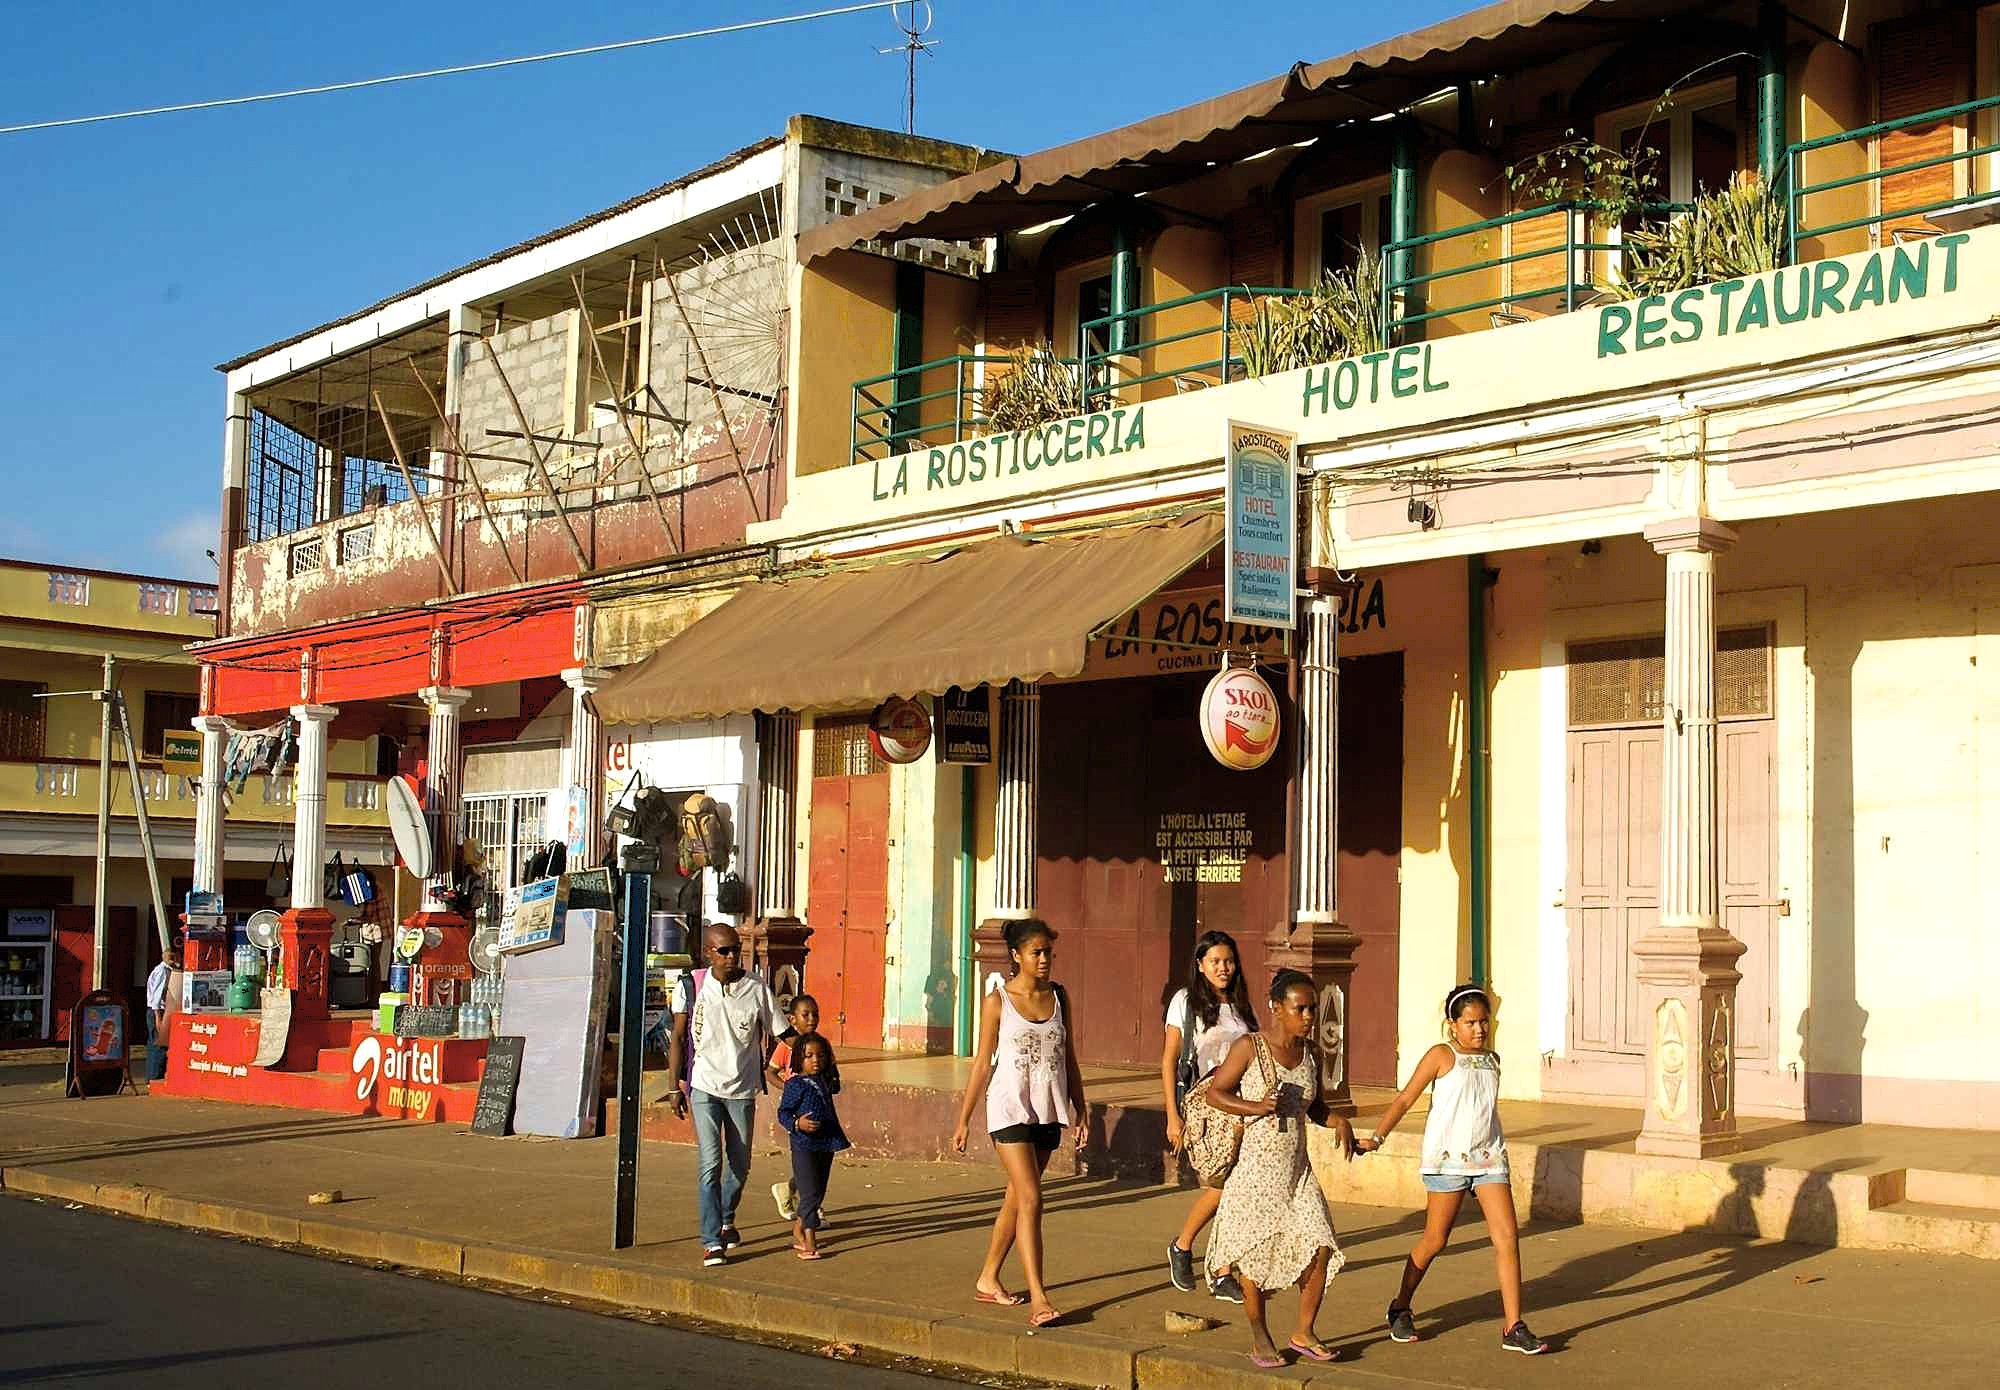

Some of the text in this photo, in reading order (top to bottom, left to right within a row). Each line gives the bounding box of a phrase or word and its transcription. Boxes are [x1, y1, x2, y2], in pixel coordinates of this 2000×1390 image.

[1598, 233, 1970, 359] RESTAURANT
[1303, 344, 1449, 417] HOTEL
[873, 406, 1146, 501] LA ROSTICCERIA
[1245, 495, 1277, 516] HOTEL
[1232, 549, 1290, 573] RESTAURANT
[1105, 607, 1141, 659] LA
[1158, 653, 1203, 672] CUCINA
[1225, 688, 1271, 711] SKOL
[1156, 829, 1253, 847] EST ACCESSIBLE PAR
[1161, 848, 1246, 865] LA PETITE RUELLE
[1163, 866, 1241, 883] JUSTE DERRIERE
[425, 964, 466, 976] orange
[384, 1036, 440, 1085] airtel
[388, 1086, 432, 1119] money
